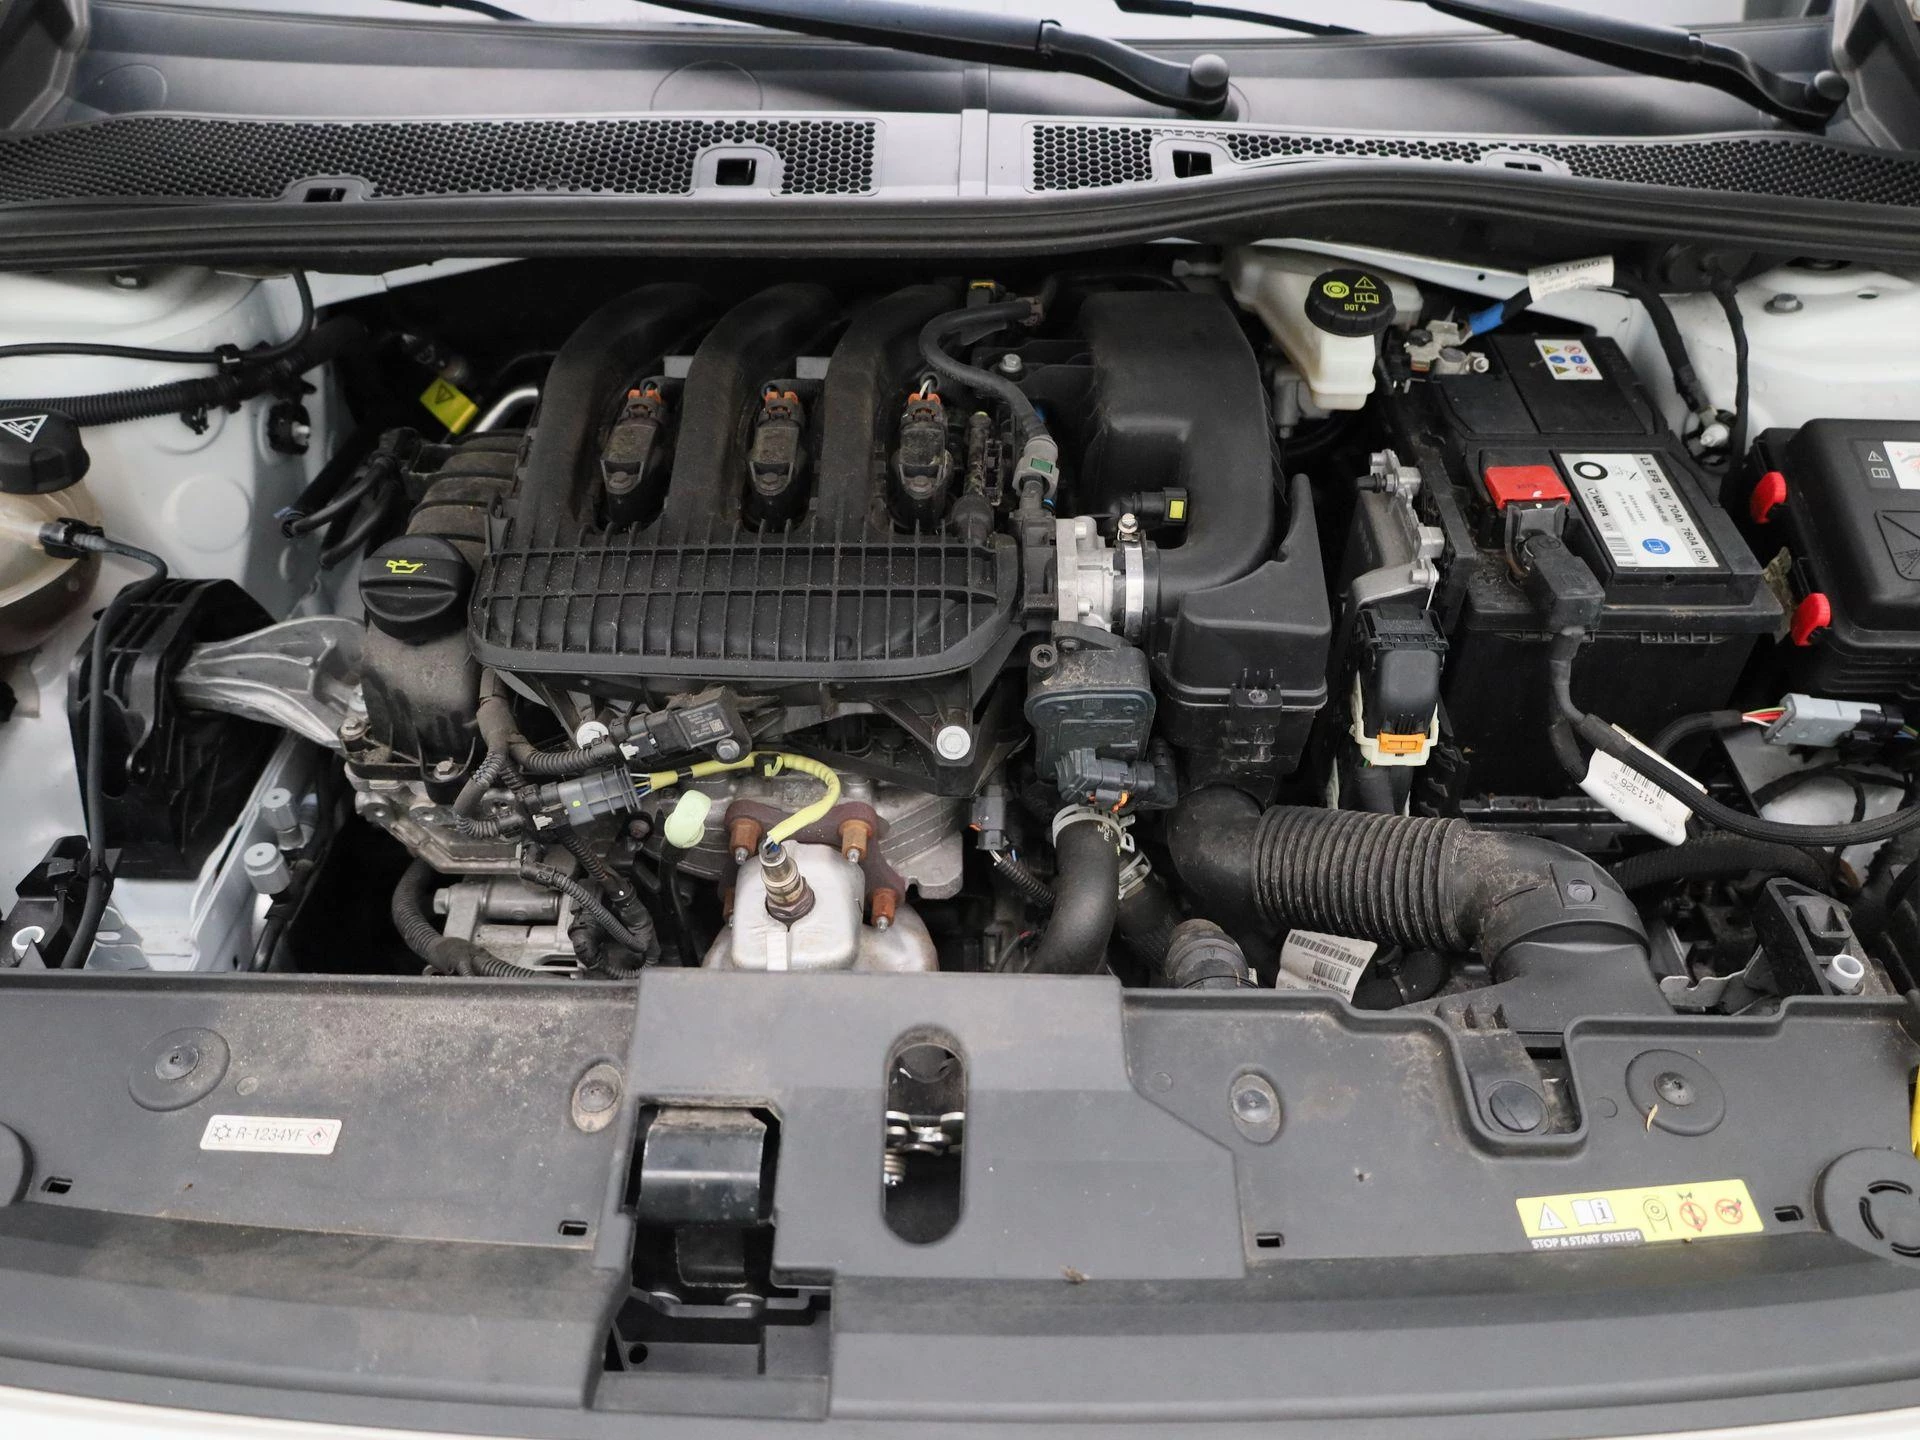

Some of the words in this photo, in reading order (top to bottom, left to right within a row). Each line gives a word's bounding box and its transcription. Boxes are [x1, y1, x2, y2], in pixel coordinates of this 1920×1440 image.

[1344, 303, 1359, 311] DOT
[1360, 304, 1367, 312] 4
[1639, 457, 1651, 466] L3
[1647, 469, 1661, 483] EFB
[1658, 487, 1673, 501] 12V
[1668, 504, 1684, 523] 70Ah
[1681, 527, 1699, 546] 760A
[1692, 547, 1709, 564] (EN)
[1621, 778, 1655, 805] 411326
[235, 1126, 305, 1142] R-1234YF
[1531, 1237, 1559, 1250] STOP
[1560, 1236, 1569, 1247] &
[1569, 1233, 1601, 1246] START
[1601, 1230, 1641, 1243] SYSTEM
